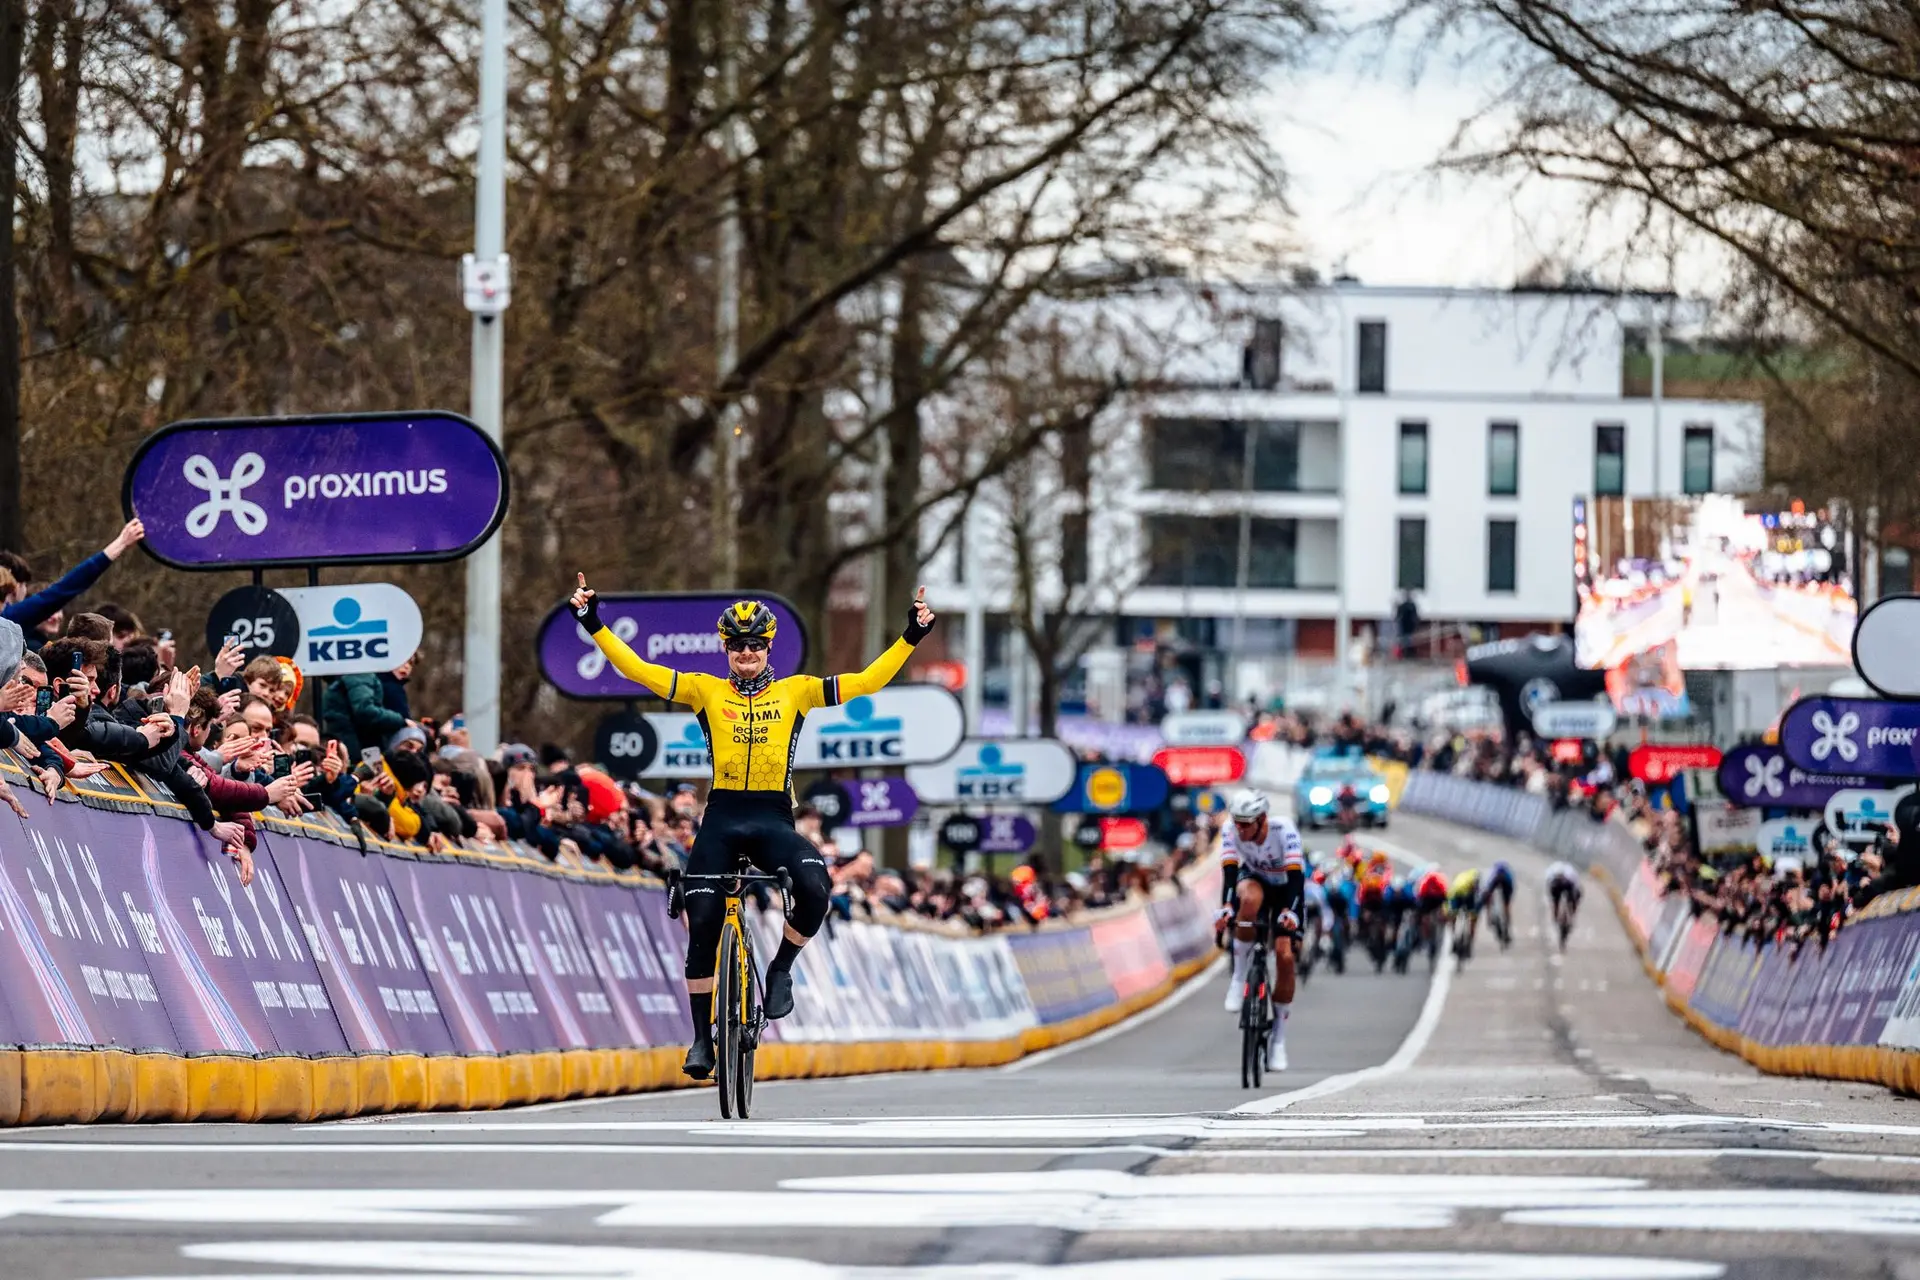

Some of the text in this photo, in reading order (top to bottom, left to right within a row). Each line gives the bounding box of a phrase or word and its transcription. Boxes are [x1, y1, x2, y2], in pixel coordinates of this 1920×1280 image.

[284, 468, 448, 509] proximus
[231, 617, 276, 649] 25
[308, 637, 389, 662] KBC
[609, 731, 645, 758] 50
[820, 737, 903, 760] KBC
[957, 780, 1023, 797] KBC
